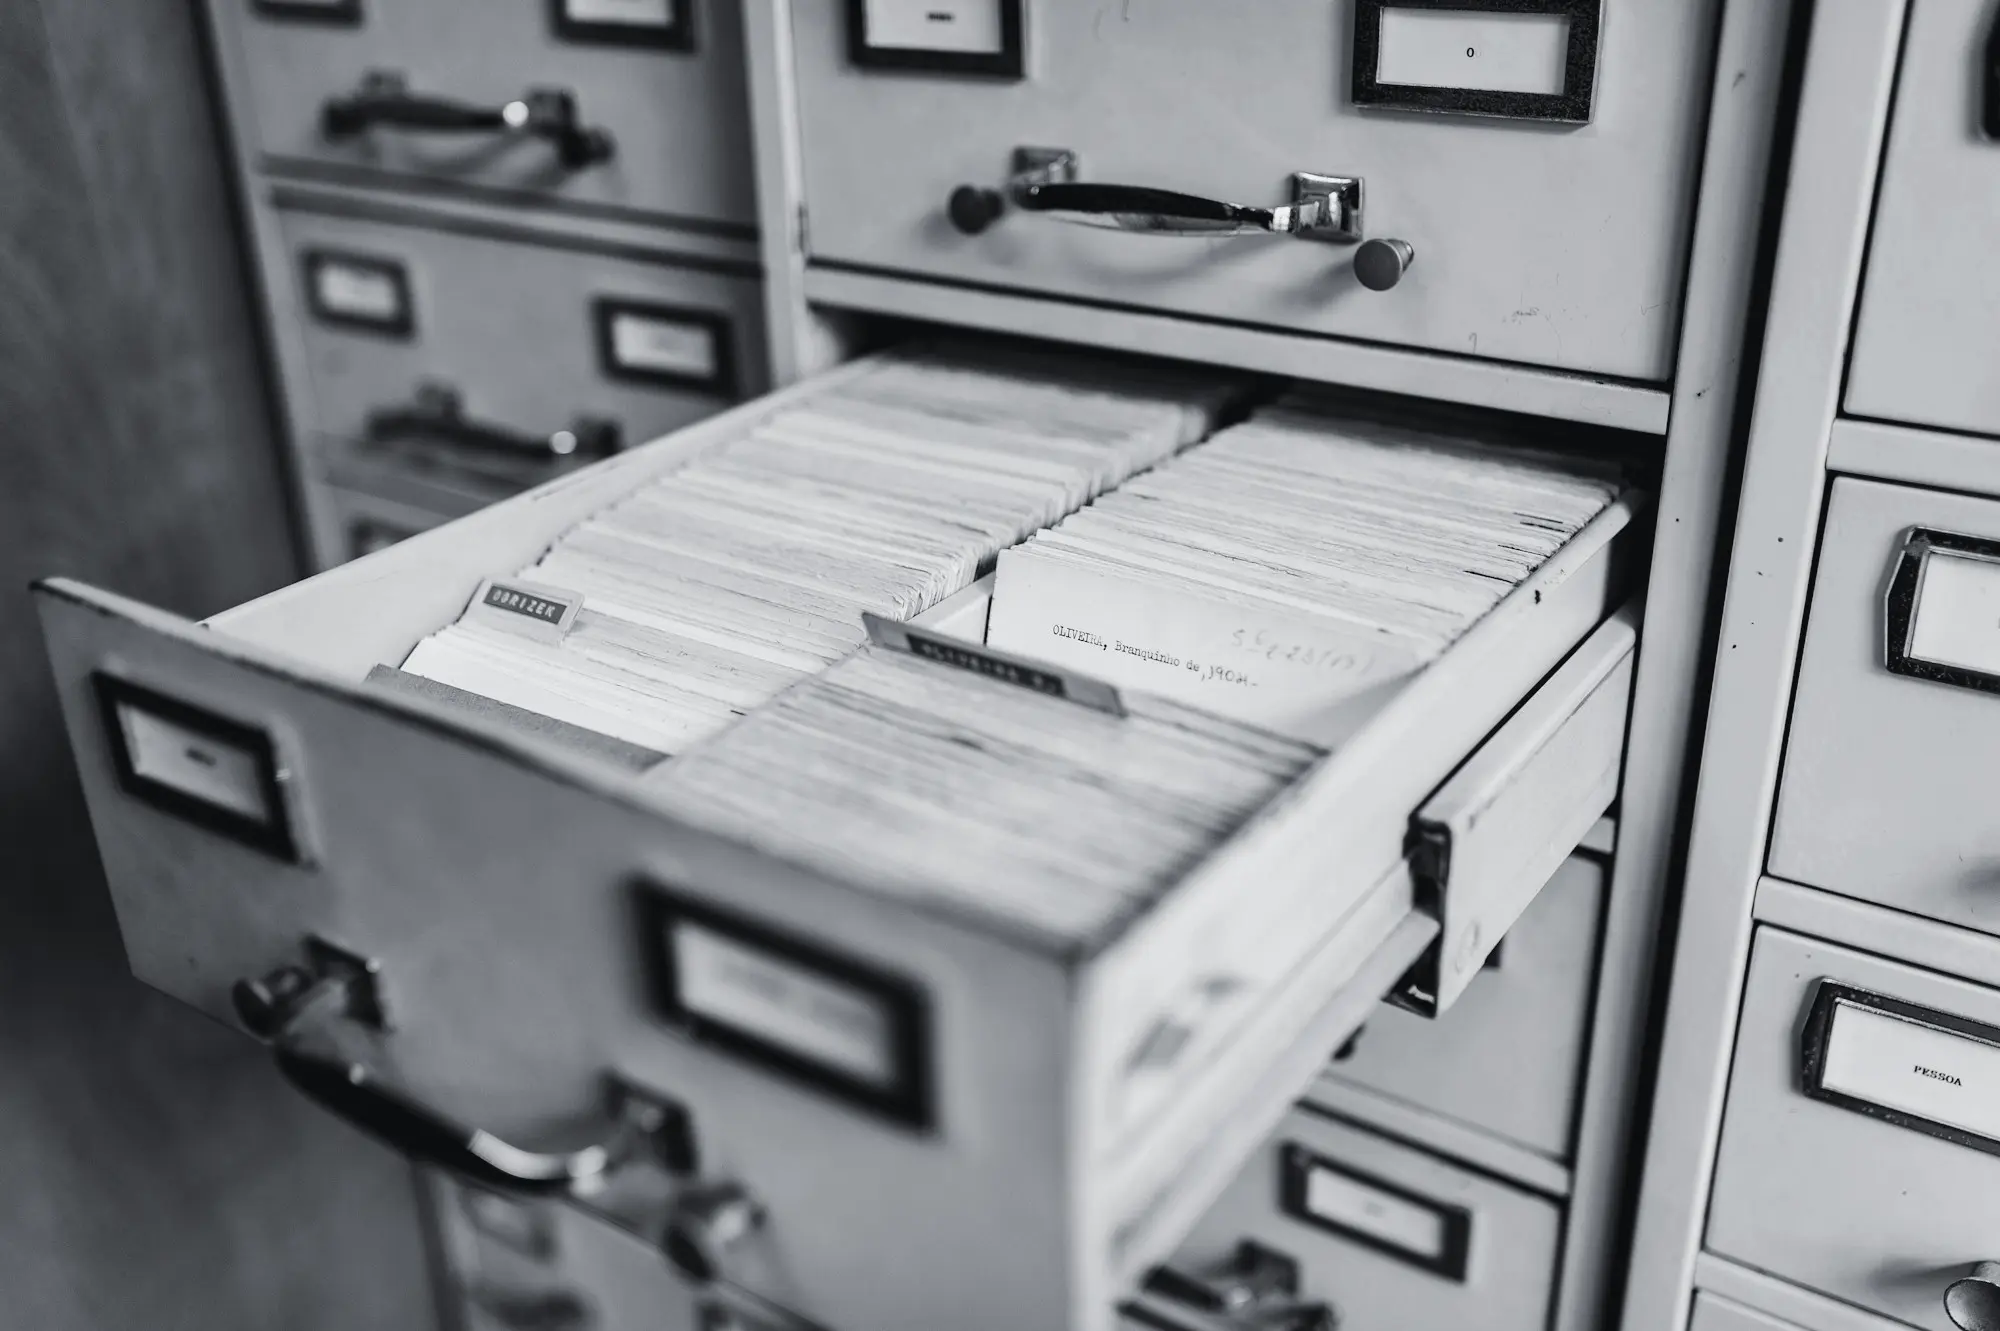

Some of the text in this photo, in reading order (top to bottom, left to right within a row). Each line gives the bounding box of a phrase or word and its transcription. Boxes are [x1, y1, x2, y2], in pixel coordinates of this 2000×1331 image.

[1052, 624, 1107, 651] OLIVEIRA,
[1114, 640, 1180, 666] Branquinho
[1913, 1065, 1962, 1087] PESSOA
